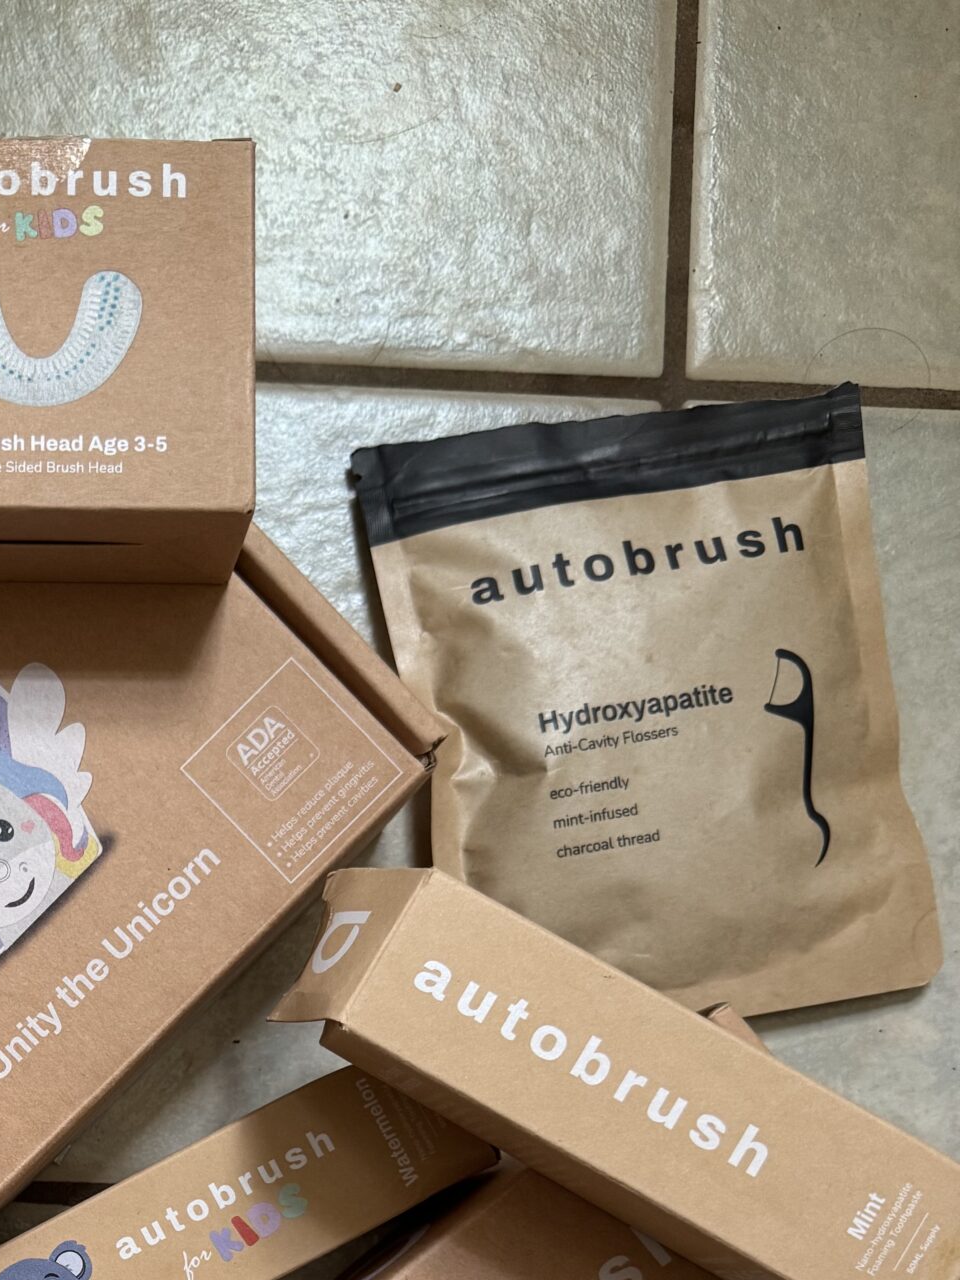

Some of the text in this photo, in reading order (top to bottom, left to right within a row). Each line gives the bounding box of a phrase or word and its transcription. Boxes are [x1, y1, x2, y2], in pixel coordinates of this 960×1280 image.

[14, 205, 105, 241] KIDS
[5, 460, 43, 474] Sided
[46, 460, 85, 474] Brush
[88, 461, 123, 475] Head
[30, 435, 84, 453] Head
[87, 435, 130, 456] Age
[133, 436, 168, 454] 3-5
[470, 516, 805, 606] autobrush
[537, 683, 734, 735] Hydroxyapatite
[235, 715, 286, 767] ADA
[250, 729, 296, 777] Accepted
[543, 725, 680, 758] Anti-Cavity Flossers
[270, 760, 356, 843] Helps reduce plaque
[280, 759, 376, 853] Helps prevent gingivitis
[549, 775, 630, 801] eco-friendly
[291, 775, 380, 864] Helps prevent cavities
[552, 803, 639, 829] mint-infused
[556, 829, 661, 859] charcoal thread
[55, 957, 112, 1012] the
[100, 845, 222, 960] Unicorn
[412, 958, 769, 1178] autobrush
[355, 1077, 420, 1188] Watermelon
[114, 1129, 336, 1261] autobrush
[846, 1191, 887, 1241] Mint
[209, 1182, 308, 1262] KIDS
[854, 1182, 914, 1272] Nano-hydroxyapatite
[866, 1189, 924, 1277] Foaming Toothpaste
[919, 1224, 941, 1252] Supply
